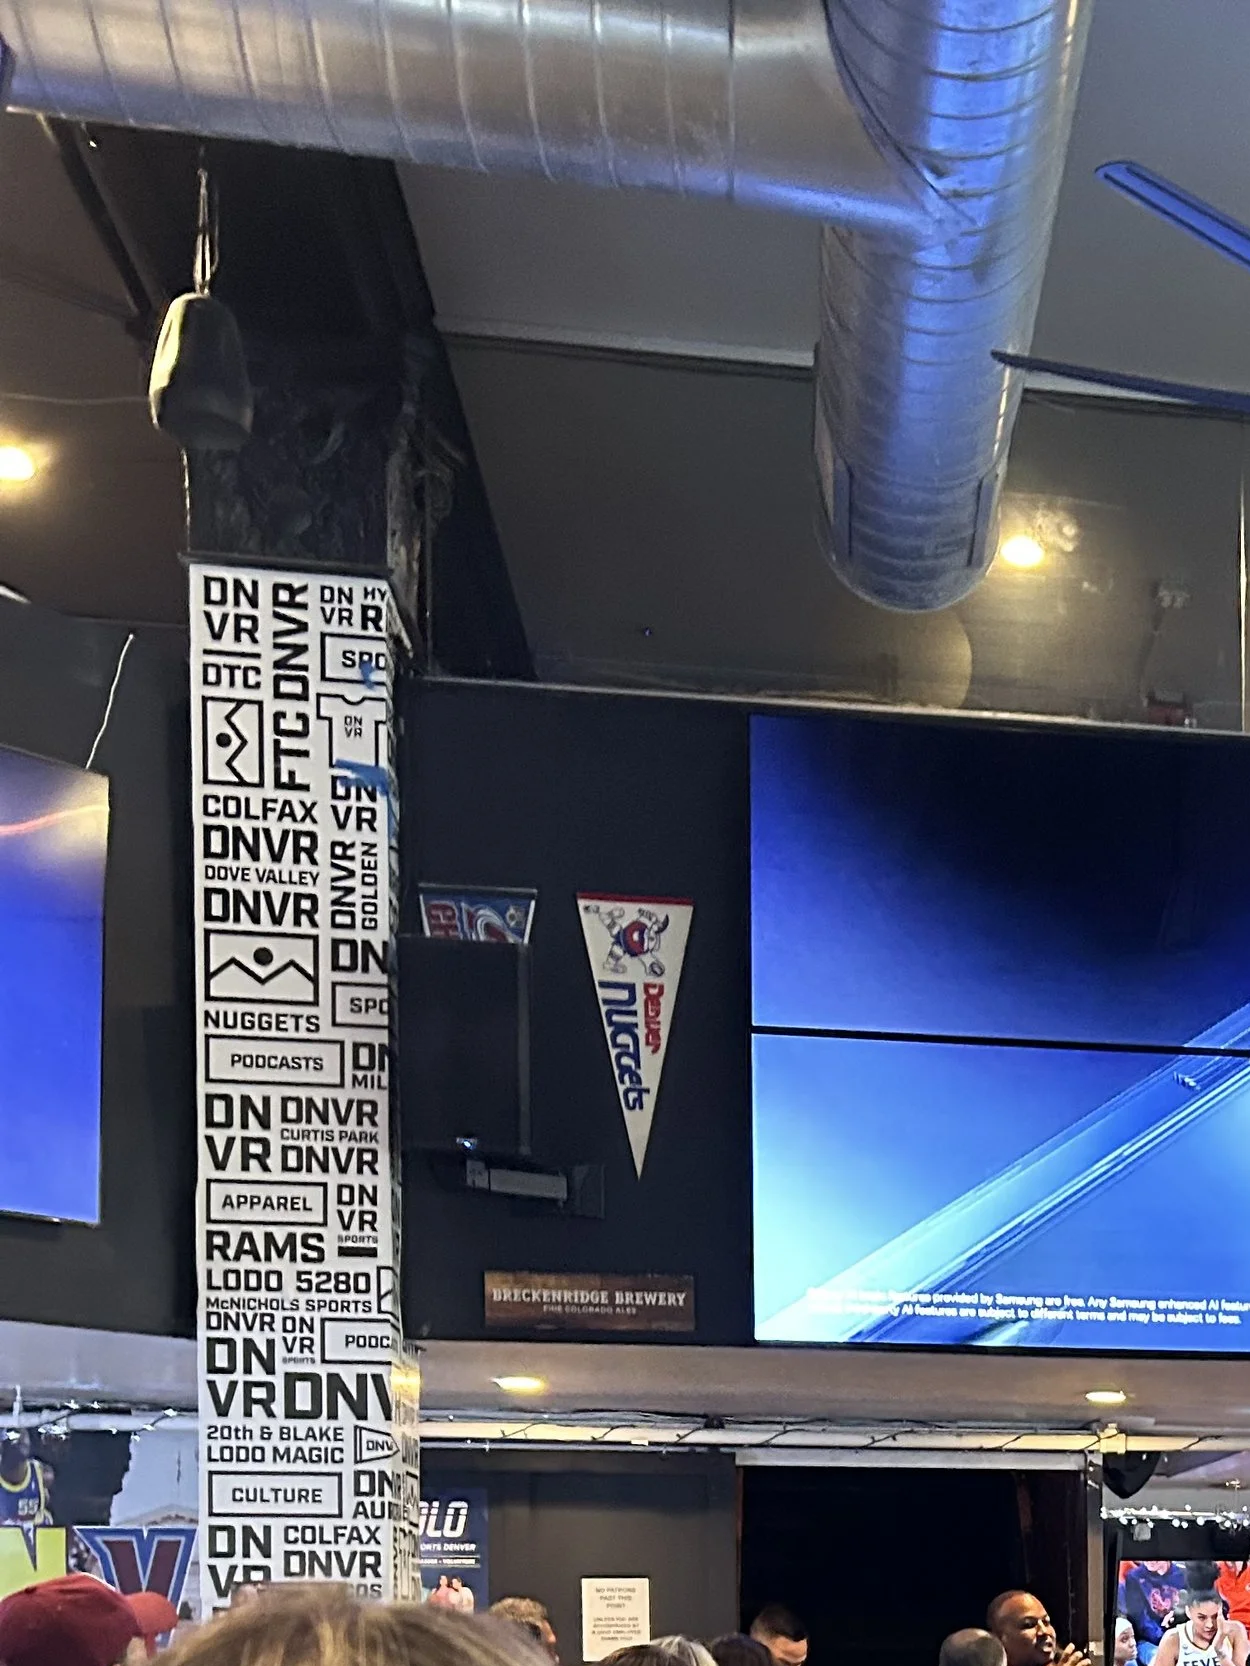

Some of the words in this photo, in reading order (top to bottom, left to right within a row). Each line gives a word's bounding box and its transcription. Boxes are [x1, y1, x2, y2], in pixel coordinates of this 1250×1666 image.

[203, 576, 259, 609] DN
[320, 585, 353, 604] DN
[204, 610, 259, 643] VR
[320, 607, 353, 627] VR
[273, 582, 309, 701] DNVR
[203, 663, 261, 689] DTC
[273, 711, 310, 791] FTC
[203, 794, 318, 824] COLFAX
[331, 805, 378, 832] VR
[203, 824, 319, 866] DNVR
[204, 865, 251, 882] DOVE
[255, 868, 320, 886] VALLEY
[331, 840, 356, 930] DNVR
[361, 841, 378, 930] GOLDEN
[203, 887, 319, 928] DNVR
[203, 1009, 320, 1033] NUGGETS
[231, 1053, 323, 1072] PODCASTS
[205, 1093, 271, 1130] DN
[280, 1095, 378, 1127] DNVR
[280, 1128, 334, 1142] CURTIS
[339, 1130, 379, 1143] PARK
[205, 1134, 272, 1173] VR
[281, 1145, 378, 1175] DNVR
[221, 1194, 313, 1212] APPAREL
[337, 1184, 378, 1206] DN
[337, 1210, 378, 1232] VR
[206, 1230, 325, 1263] RAMS
[206, 1268, 283, 1292] LODO
[296, 1271, 371, 1294] 5280
[206, 1298, 299, 1311] McNICHOLS
[305, 1299, 372, 1313] SPORTS
[492, 1287, 609, 1304] BRECKENRIDGE
[614, 1290, 686, 1307] BREWERY
[933, 1292, 977, 1305] provided
[980, 1293, 992, 1306] by
[996, 1294, 1043, 1308] Samsung
[1089, 1296, 1107, 1309] Any
[1109, 1296, 1156, 1310] Samsung
[206, 1312, 275, 1332] DNVR
[282, 1316, 315, 1334] DN
[206, 1337, 275, 1375] DN
[282, 1336, 315, 1354] VR
[206, 1380, 276, 1418] VR
[207, 1425, 253, 1441] 20th
[260, 1427, 273, 1441] &
[279, 1427, 344, 1442] BLAKE
[207, 1445, 266, 1464] LODO
[273, 1446, 344, 1464] MAGIC
[231, 1487, 323, 1504] CULTURE
[207, 1525, 272, 1558] DN
[283, 1526, 382, 1545] COLFAX
[283, 1550, 382, 1578] DNVR
